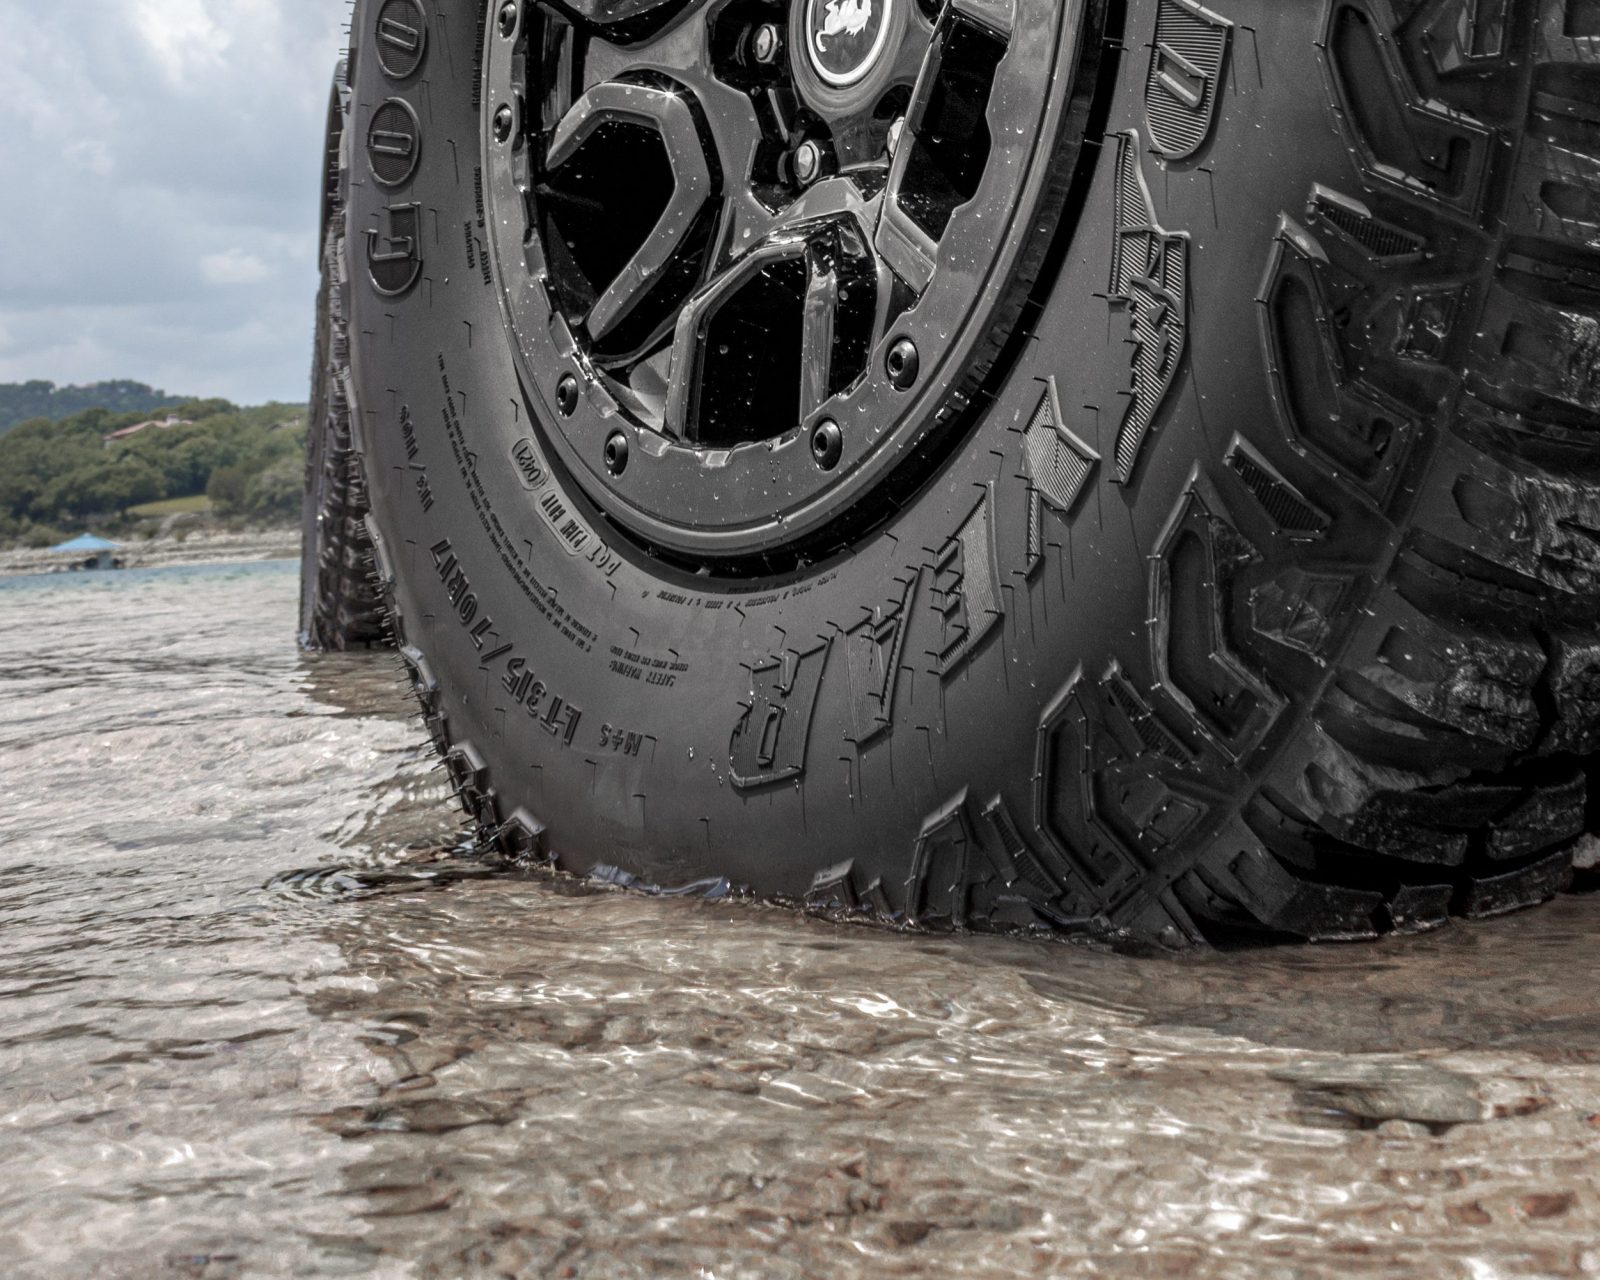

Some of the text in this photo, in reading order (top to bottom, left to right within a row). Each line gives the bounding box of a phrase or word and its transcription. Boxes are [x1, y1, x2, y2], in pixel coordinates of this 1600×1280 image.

[514, 444, 542, 483] 0421
[584, 545, 622, 577] DOT
[429, 537, 581, 746] LT315/70R17
[645, 671, 676, 688] SAFETY
[600, 723, 643, 757] M+S
